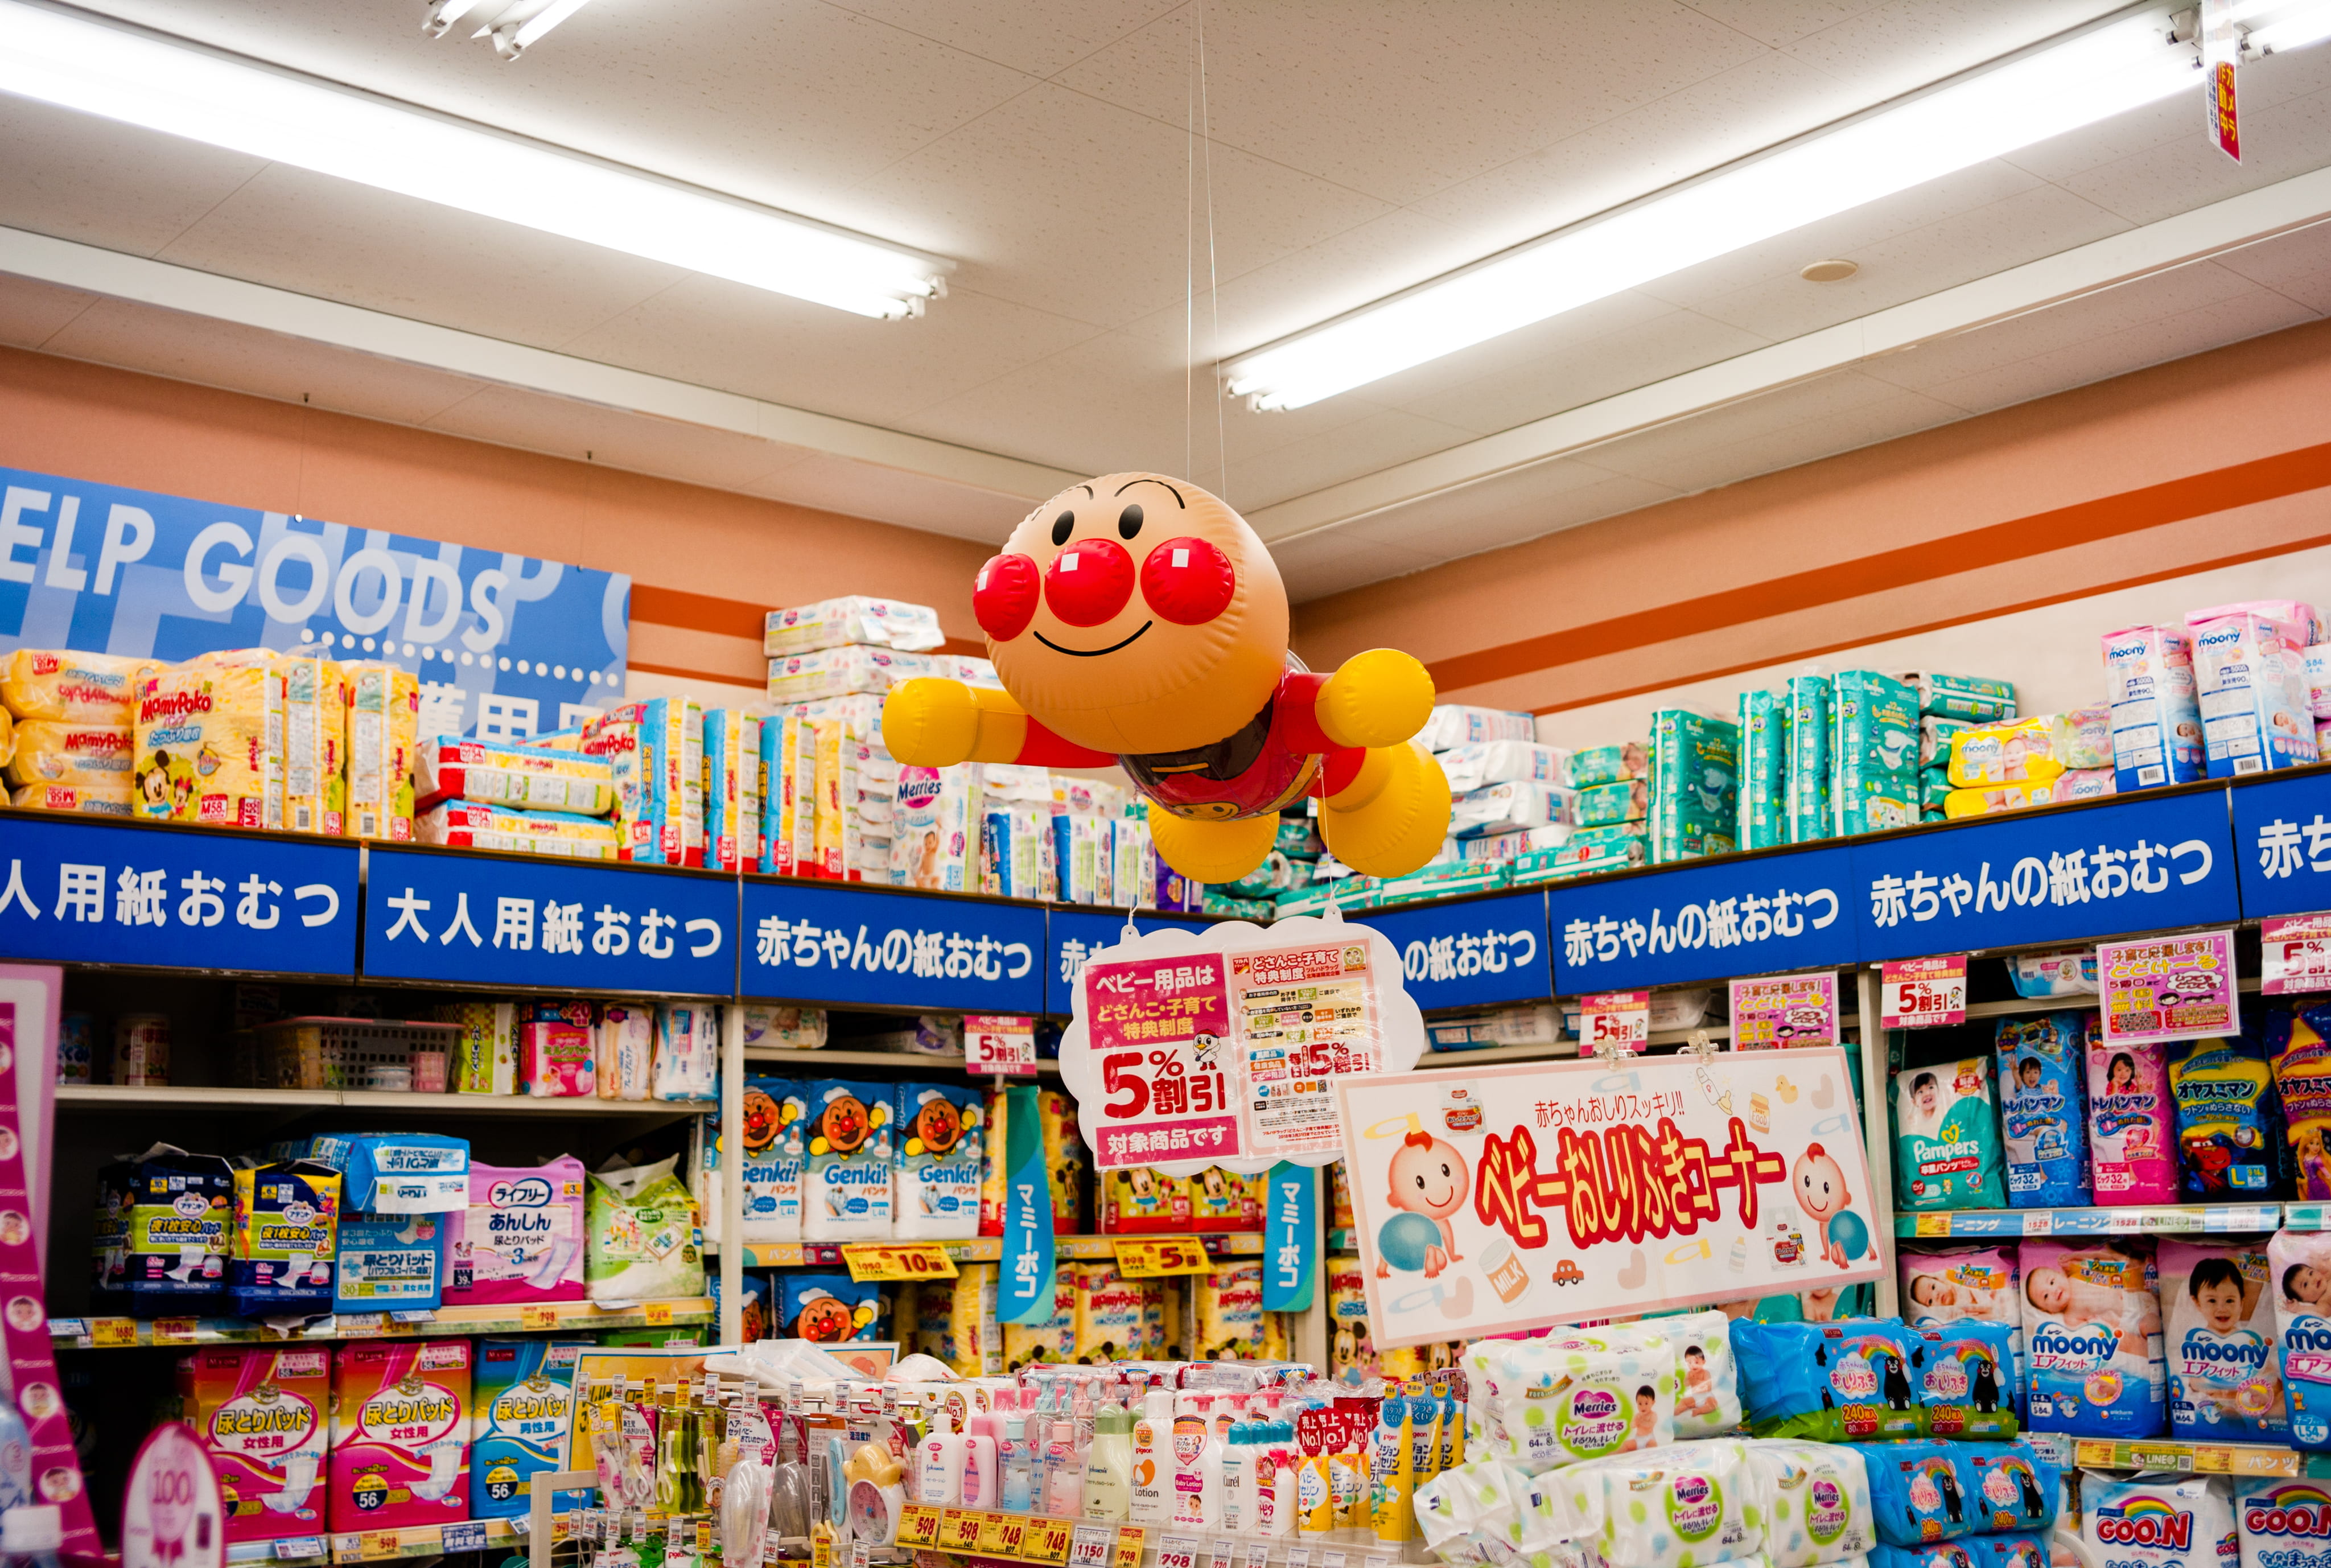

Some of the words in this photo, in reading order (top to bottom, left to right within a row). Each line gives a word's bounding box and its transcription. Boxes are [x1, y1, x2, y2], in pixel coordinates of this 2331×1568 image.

[0, 485, 155, 596] ELP
[184, 521, 510, 654] GOODS
[2198, 631, 2241, 648] moony
[2109, 643, 2147, 660] moony
[140, 690, 213, 724] MamyPoko
[1962, 741, 2000, 756] moony
[897, 776, 942, 803] Merries
[1870, 838, 2213, 928] 赤ちゃんの紙おむつ
[0, 859, 340, 930] 人用紙おむつ
[385, 887, 722, 959] 大人用紙おむつ
[1565, 888, 1840, 968] 赤ちゃんの紙おむつ
[756, 915, 1032, 981] 赤ちゃんの紙おむつ
[1403, 929, 1537, 983] の紙おむつ
[2111, 939, 2213, 963] 子育て応援します!
[1253, 949, 1339, 970] どさんこ・子育て
[1306, 964, 1339, 973] ツルハドラッグ
[1899, 959, 1947, 972] ベビー用品は
[1096, 966, 1215, 994] ベビー用品は
[1253, 966, 1305, 985] 特典制度
[1096, 995, 1217, 1022] どさんこ・子育て
[1898, 1013, 1949, 1026] 対象商品です
[1123, 1019, 1194, 1040] 特典制度
[2177, 1082, 2256, 1100] オヤスミマン
[1534, 1091, 1685, 1129] 赤ちゃんおしりスッキリ!!
[2002, 1094, 2065, 1113] トレパンマン
[2091, 1094, 2157, 1112] トレパンマン
[2183, 1102, 2250, 1115] フトンをぬらさない
[1751, 1110, 1767, 1126] FOOD
[1107, 1125, 1228, 1155] 対象商品です
[1913, 1138, 1980, 1163] Pampers
[824, 1162, 888, 1185] Genki!
[918, 1163, 979, 1184] Genki!
[2231, 1167, 2246, 1186] L
[770, 1184, 797, 1195] パンツ
[861, 1186, 888, 1196] パンツ
[953, 1185, 977, 1196] パンツ
[1475, 1117, 1787, 1249] ベビーおしりふきコーナー
[495, 1188, 546, 1203] ライフリー
[180, 1201, 204, 1211] アテント
[288, 1209, 311, 1218] アテント
[489, 1212, 551, 1232] あんしん
[2028, 1220, 2048, 1229] 1528
[493, 1234, 545, 1246] 尿とりパッド
[1012, 1183, 1037, 1298] マミーポコ
[1277, 1182, 1302, 1288] マミーポコ
[363, 1253, 433, 1266] 尿とりパッド
[1494, 1265, 1522, 1297] MILK
[115, 1326, 134, 1339] 1680
[2032, 1335, 2119, 1361] moony
[2181, 1341, 2270, 1369] moony
[2032, 1354, 2088, 1370] エアフィット
[2181, 1360, 2240, 1377] エアフィット
[1830, 1370, 1879, 1394] おしりふき
[1924, 1371, 1969, 1394] おしりふき
[364, 1396, 454, 1427] 尿とりパッド
[946, 1405, 963, 1418] No.1
[1573, 1394, 1617, 1416] Merries
[1842, 1403, 1878, 1423] 240枚入
[1931, 1404, 1965, 1423] 240枚入
[216, 1405, 311, 1435] 尿とりパッド
[520, 1421, 555, 1434] 男性用
[1302, 1415, 1317, 1429] 売上
[390, 1426, 429, 1441] 女性用
[1563, 1422, 1624, 1437] トイレに流せる
[242, 1435, 284, 1450] 女性用
[740, 1435, 768, 1444] おていれセット
[1302, 1431, 1321, 1447] No.1
[1571, 1433, 1618, 1446] するりんキレイ
[2145, 1454, 2176, 1466] LINE@
[2248, 1455, 2296, 1471] パンツ
[1130, 1478, 1143, 1489] Baby
[1222, 1474, 1240, 1488] Curél
[359, 1491, 378, 1508] 56
[491, 1482, 510, 1500] 56
[1135, 1487, 1159, 1498] Lotion
[1676, 1485, 1709, 1501] Merries
[1813, 1489, 1840, 1505] Merries
[1983, 1484, 2019, 1501] おしりふき
[1673, 1503, 1719, 1522] トイレに流せる
[1809, 1511, 1846, 1525] トイレに流せる
[916, 1516, 936, 1536] 598
[959, 1521, 979, 1540] 598
[378, 1537, 397, 1549] 598
[1001, 1525, 1022, 1546] 748
[1045, 1530, 1066, 1551] 748
[1049, 1551, 1060, 1559] 807
[1077, 1544, 1104, 1558] 1150
[1119, 1550, 1136, 1562] 798
[1160, 1554, 1191, 1568] 798
